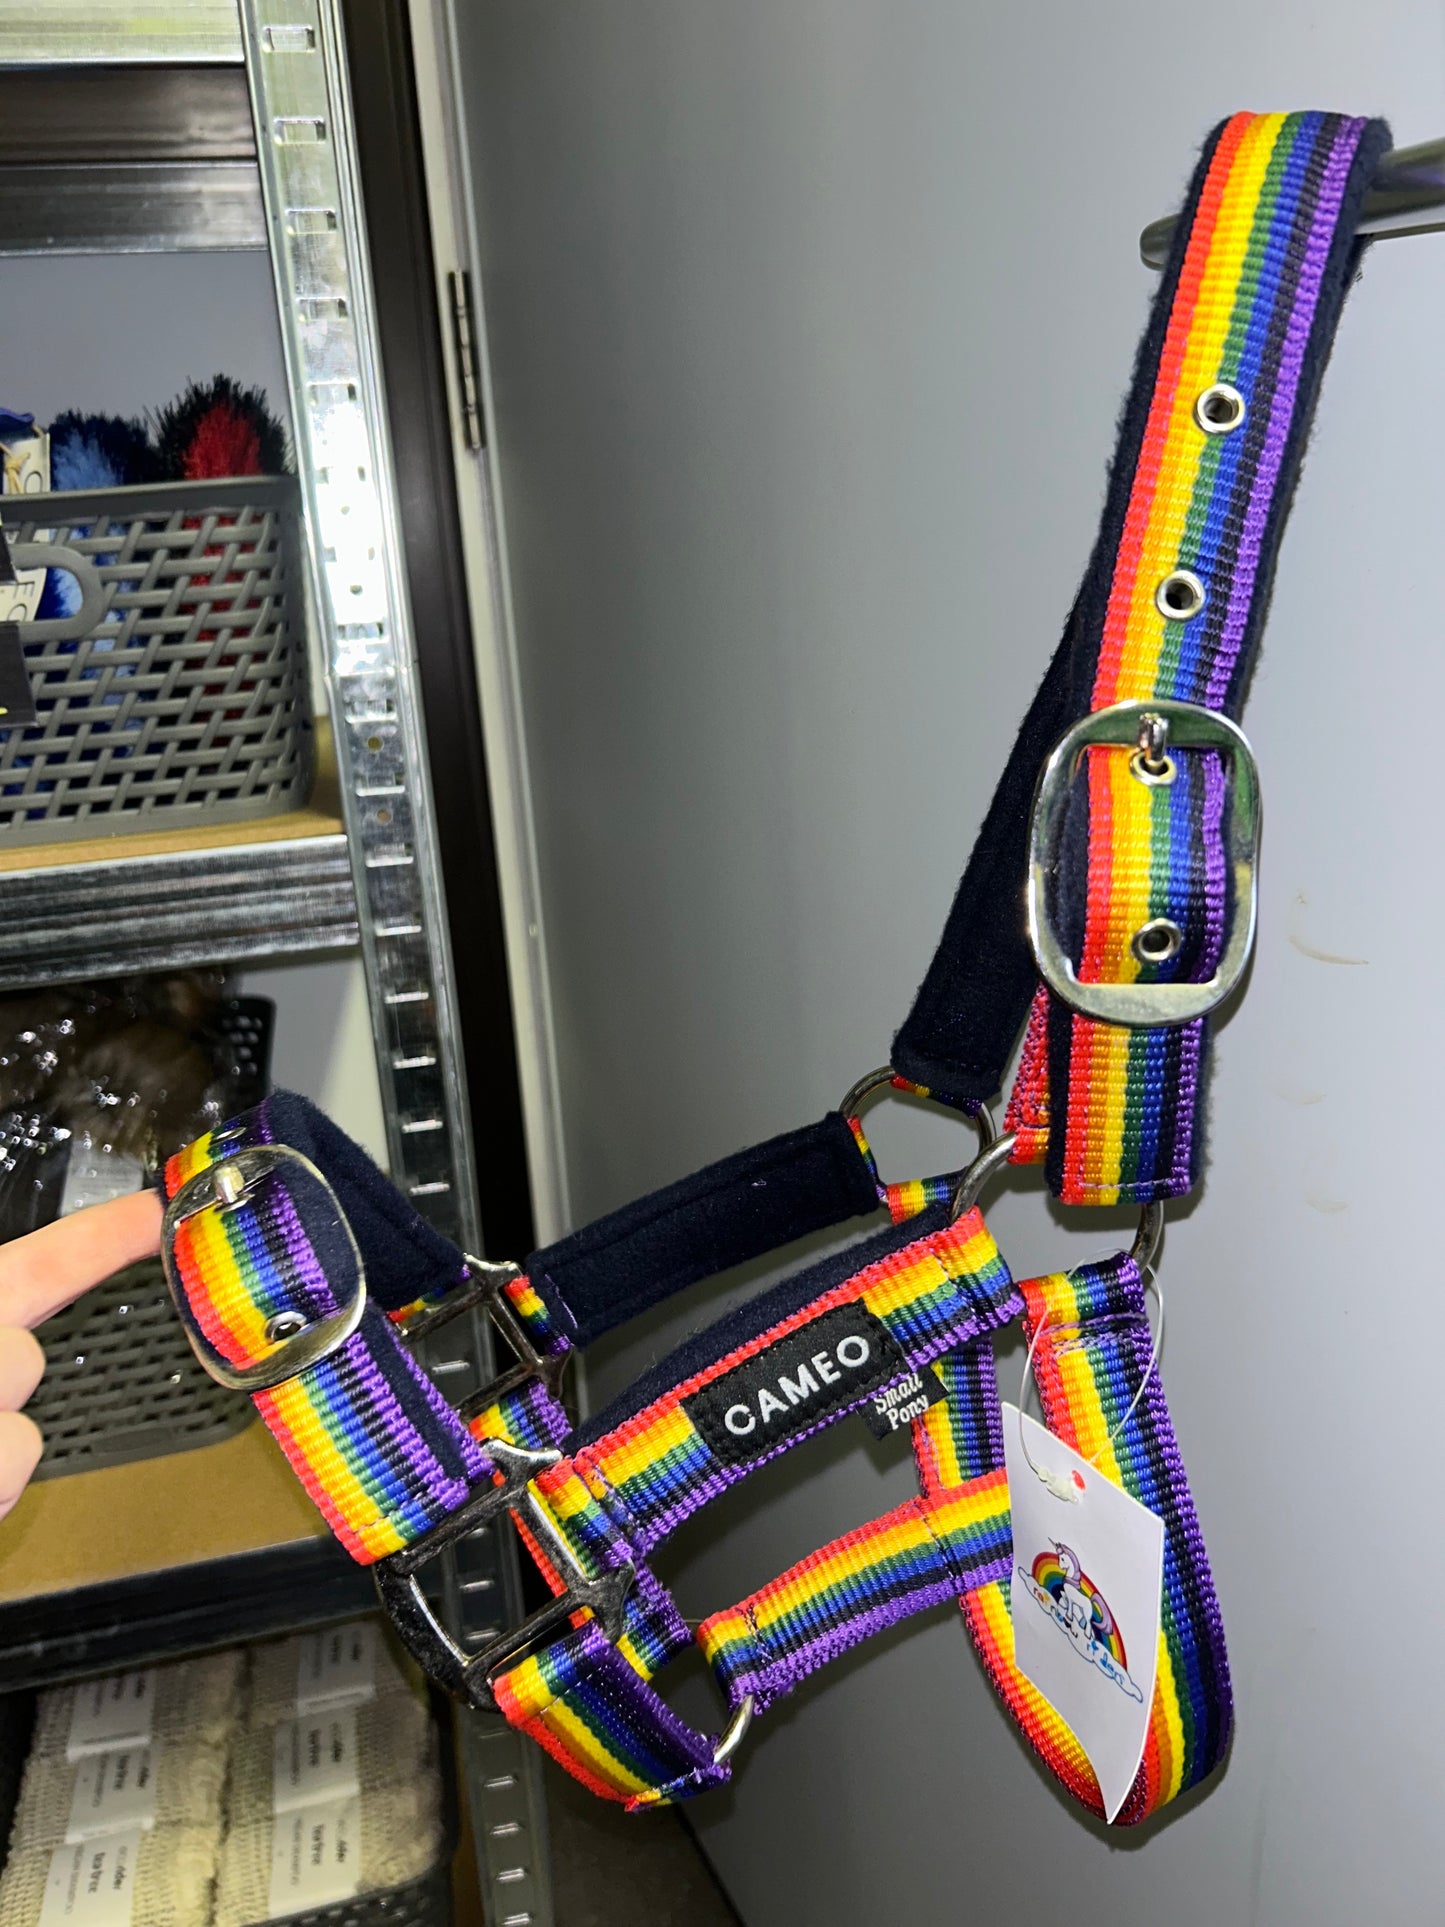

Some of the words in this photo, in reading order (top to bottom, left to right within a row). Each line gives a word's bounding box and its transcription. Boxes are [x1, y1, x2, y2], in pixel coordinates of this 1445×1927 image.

[724, 1335, 870, 1436] CAMEO
[873, 1372, 924, 1415] Small
[885, 1394, 930, 1430] Pony
